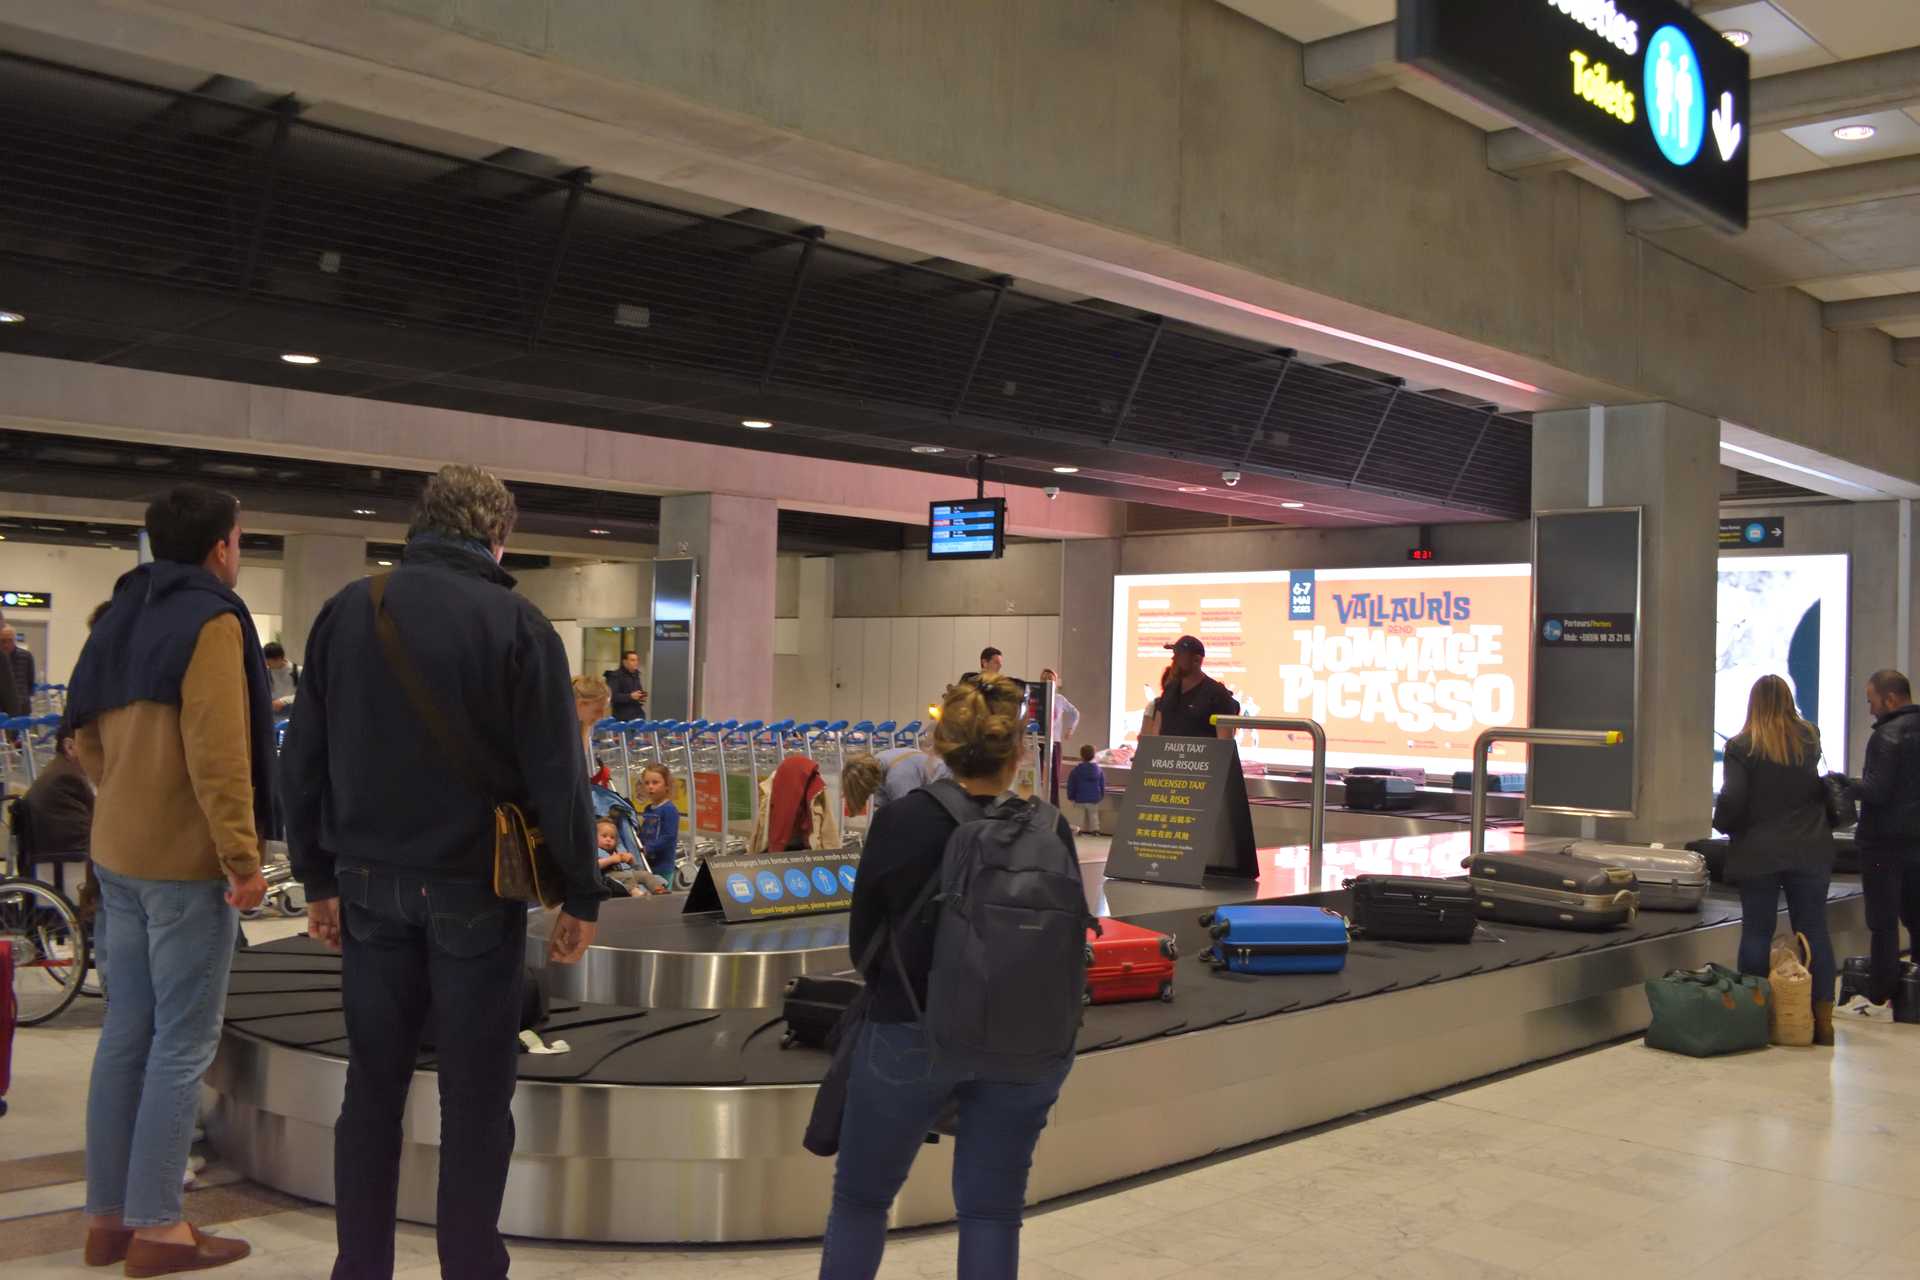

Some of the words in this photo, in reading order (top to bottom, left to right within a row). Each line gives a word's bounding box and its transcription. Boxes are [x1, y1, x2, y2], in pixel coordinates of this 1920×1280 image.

[1569, 50, 1635, 124] Toilets
[1333, 590, 1472, 627] VALLAURIS
[1293, 624, 1504, 681] HOMMAGE
[1279, 664, 1515, 733] PICASSO
[1151, 759, 1174, 769] VRAIS
[1175, 760, 1209, 771] RISQUES
[1164, 742, 1185, 752] FAUX
